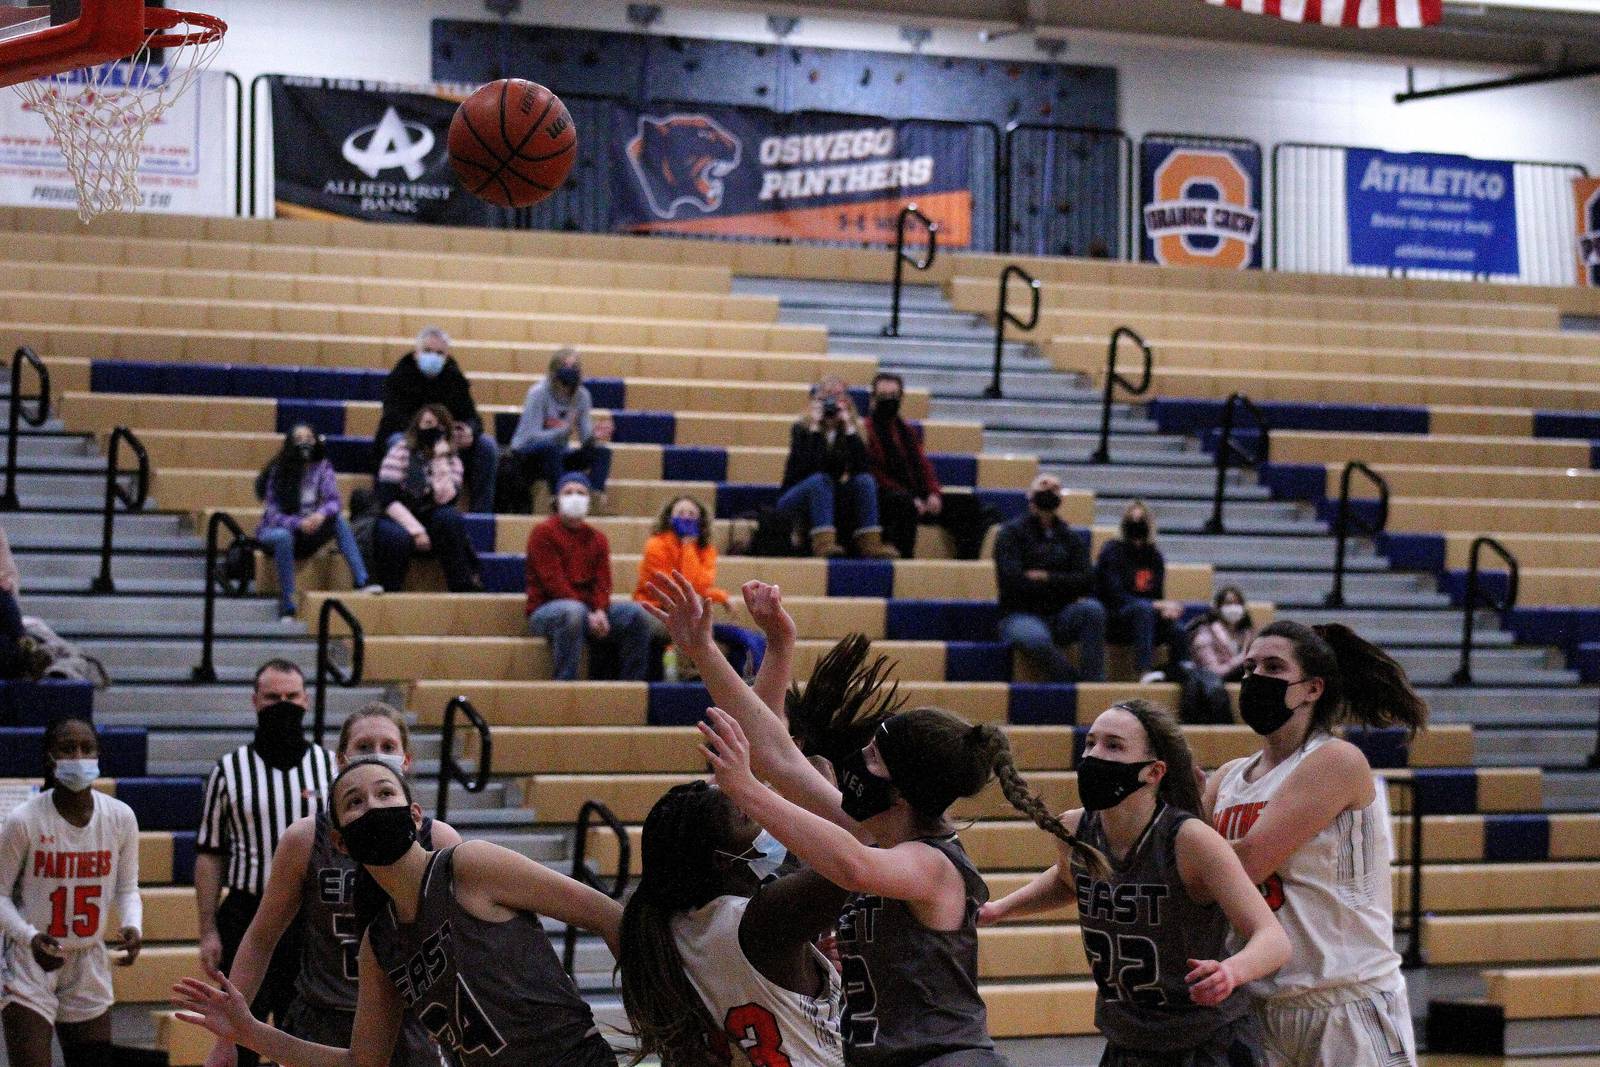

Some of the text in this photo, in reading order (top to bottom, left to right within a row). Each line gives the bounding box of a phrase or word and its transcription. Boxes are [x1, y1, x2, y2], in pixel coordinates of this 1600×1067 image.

[759, 128, 897, 166] OSWEGO
[758, 154, 935, 201] PANTHERS
[33, 850, 113, 879] PANTHERS
[47, 884, 102, 938] 15
[1076, 873, 1170, 927] EAST
[1081, 927, 1168, 1006] 22
